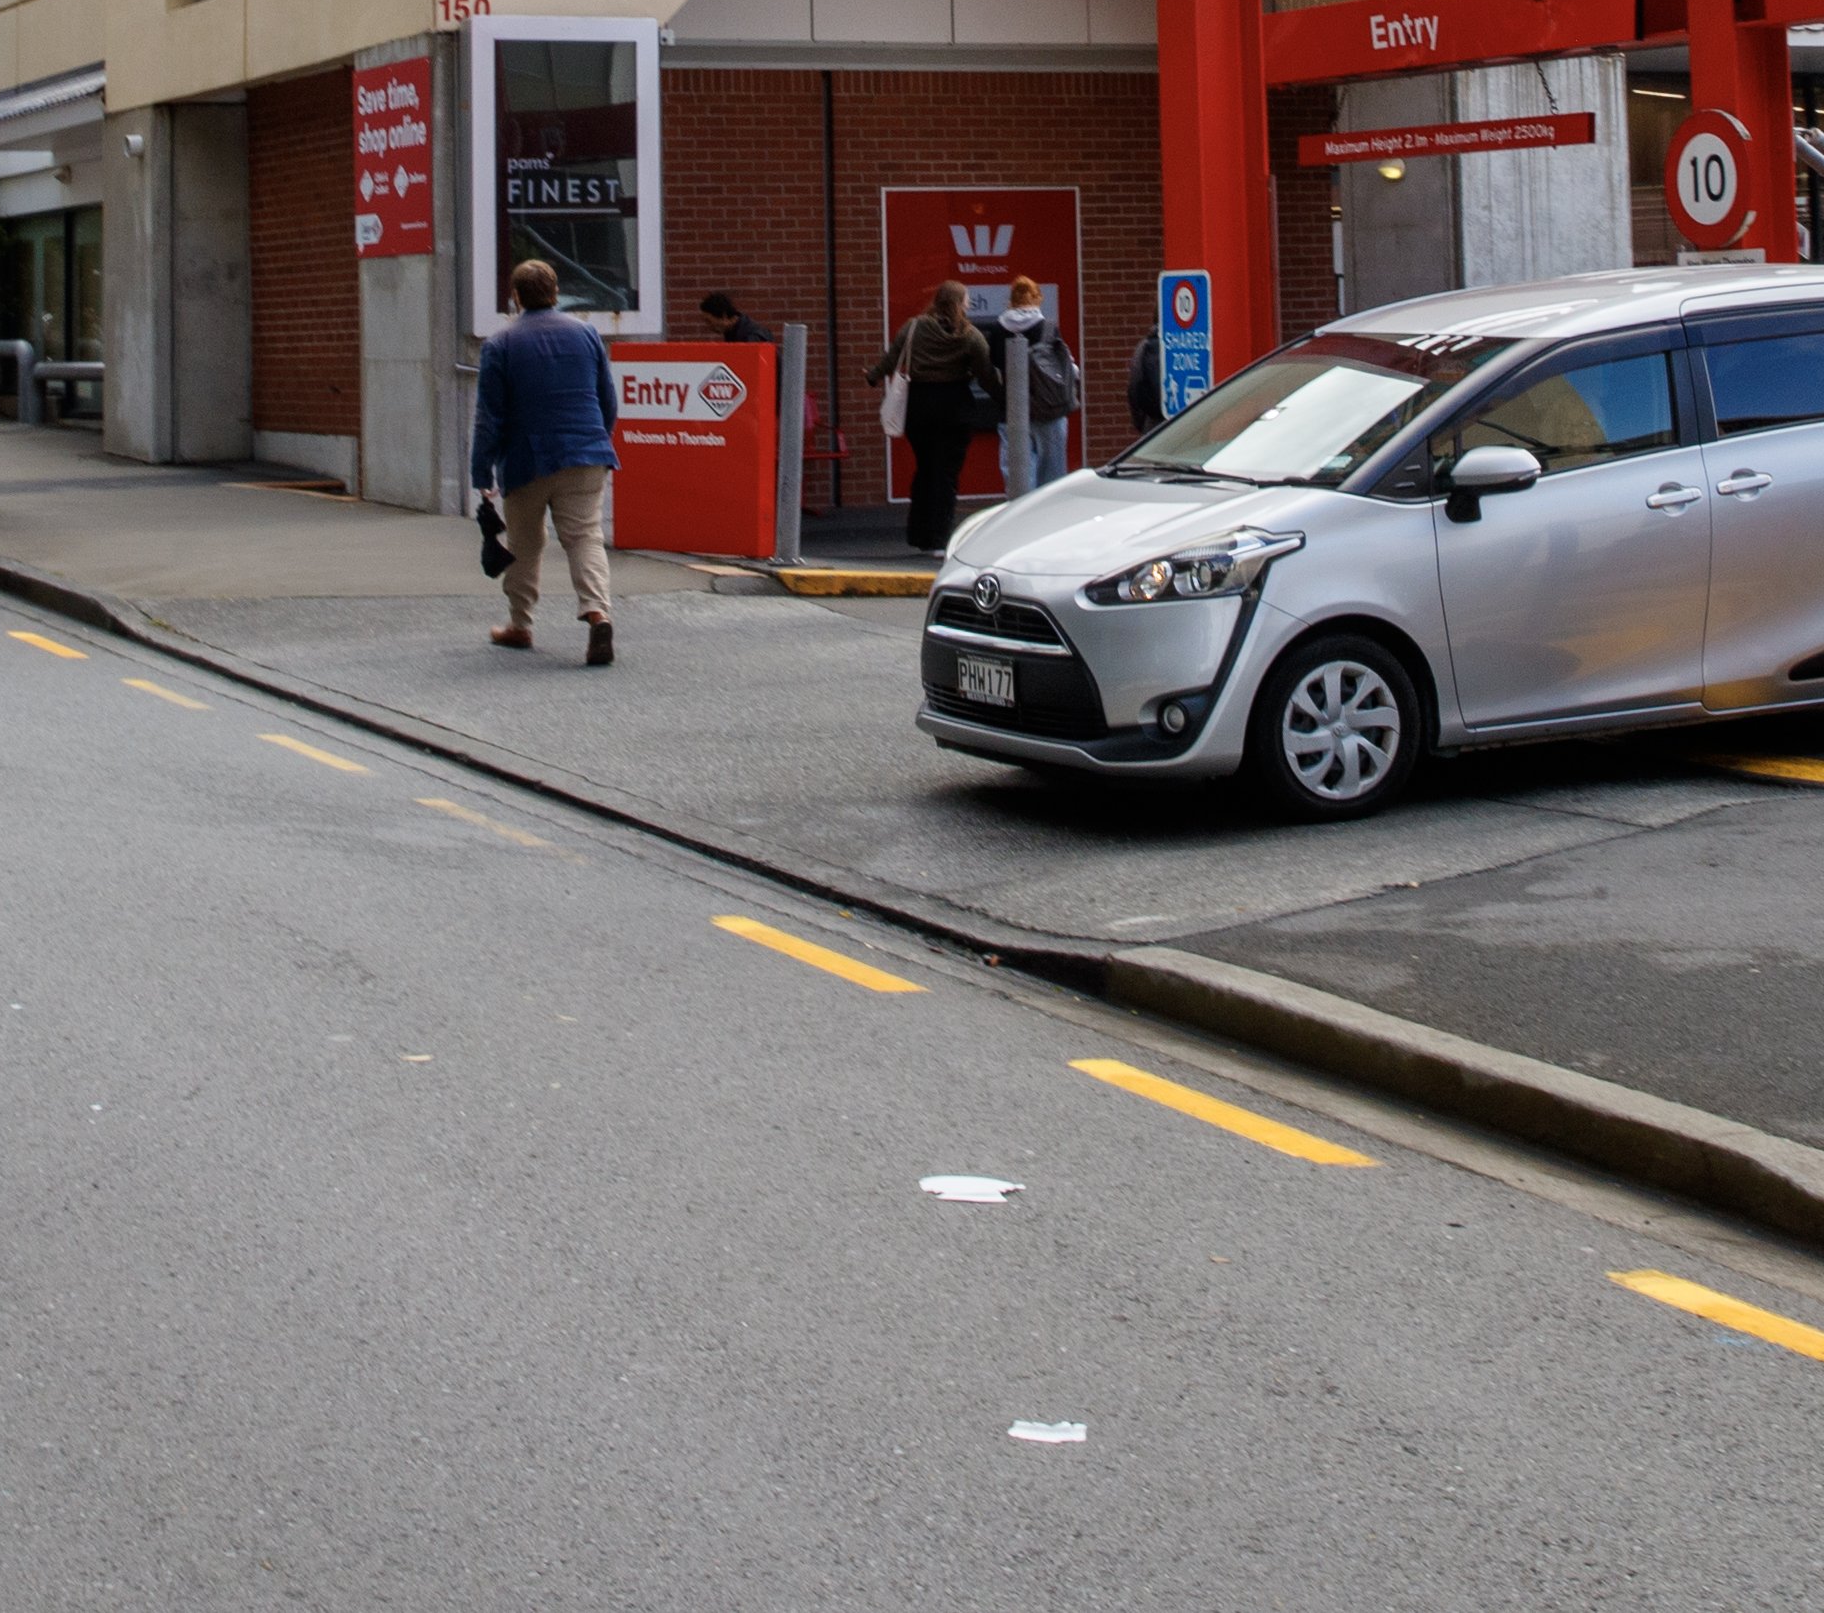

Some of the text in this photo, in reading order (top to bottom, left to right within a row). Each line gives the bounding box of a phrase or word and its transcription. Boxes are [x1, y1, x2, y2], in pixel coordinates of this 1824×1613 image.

[1370, 13, 1440, 51] Entry
[358, 77, 420, 116] Save time,
[358, 114, 427, 159] shop online
[1324, 140, 1370, 156] Maximum
[1370, 135, 1403, 154] Height
[1434, 131, 1479, 146] Maximum
[1479, 127, 1513, 144] Weight
[1513, 123, 1555, 142] 2500kg
[507, 157, 551, 175] pams
[1690, 154, 1726, 203] 10
[507, 178, 620, 204] FINEST
[957, 262, 1009, 275] Westpac
[1165, 331, 1210, 351] SHARED
[1172, 352, 1201, 371] ZONE
[622, 374, 690, 414] Entry
[708, 384, 734, 399] NW
[622, 429, 666, 445] Welcome
[677, 431, 727, 447] Thorndon
[959, 661, 1012, 697] PHW177
